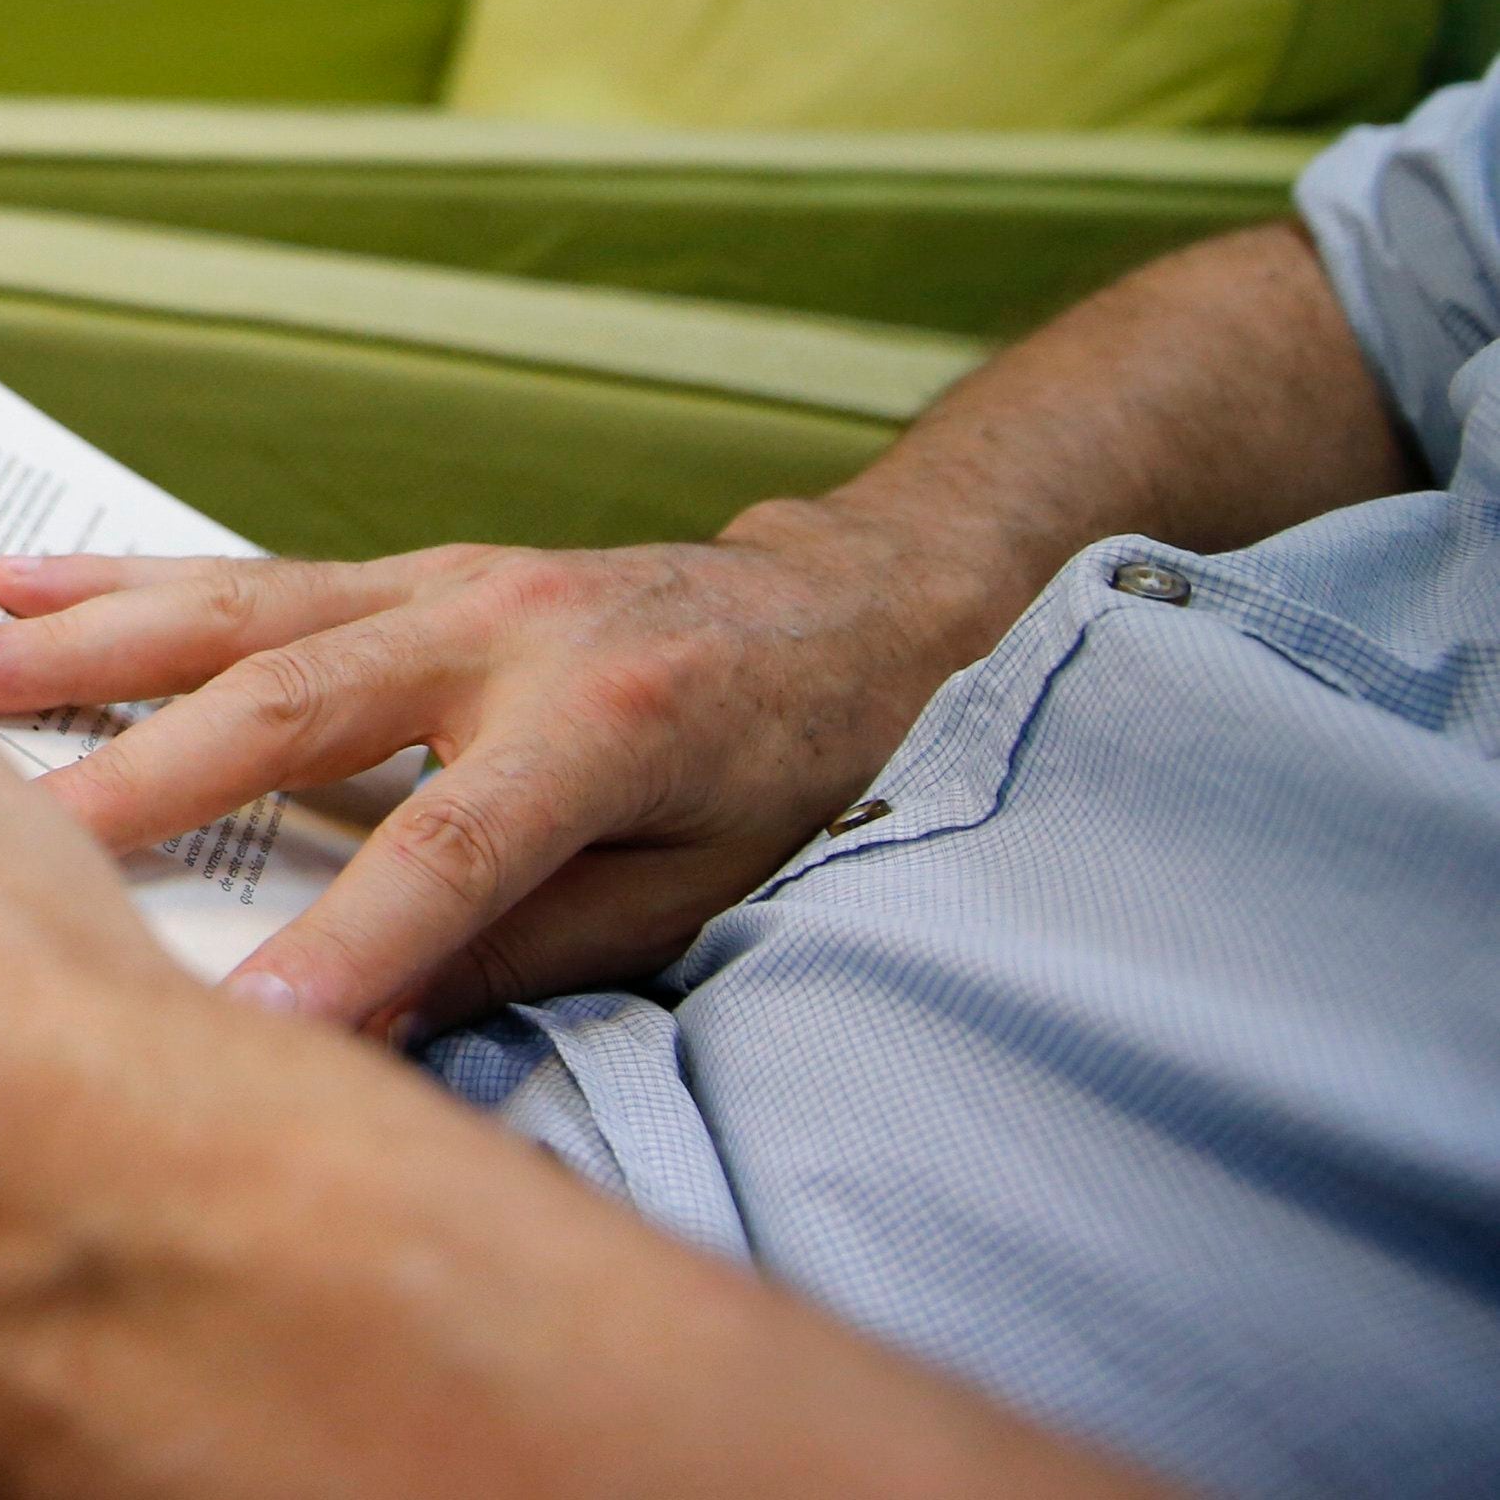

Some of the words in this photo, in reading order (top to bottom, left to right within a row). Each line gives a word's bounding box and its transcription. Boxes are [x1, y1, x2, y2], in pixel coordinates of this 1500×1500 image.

[183, 831, 206, 868] acción
[201, 816, 238, 880] corresponden
[218, 876, 234, 893] de
[228, 855, 243, 879] este
[244, 853, 267, 887] habían
[239, 884, 255, 907] que
